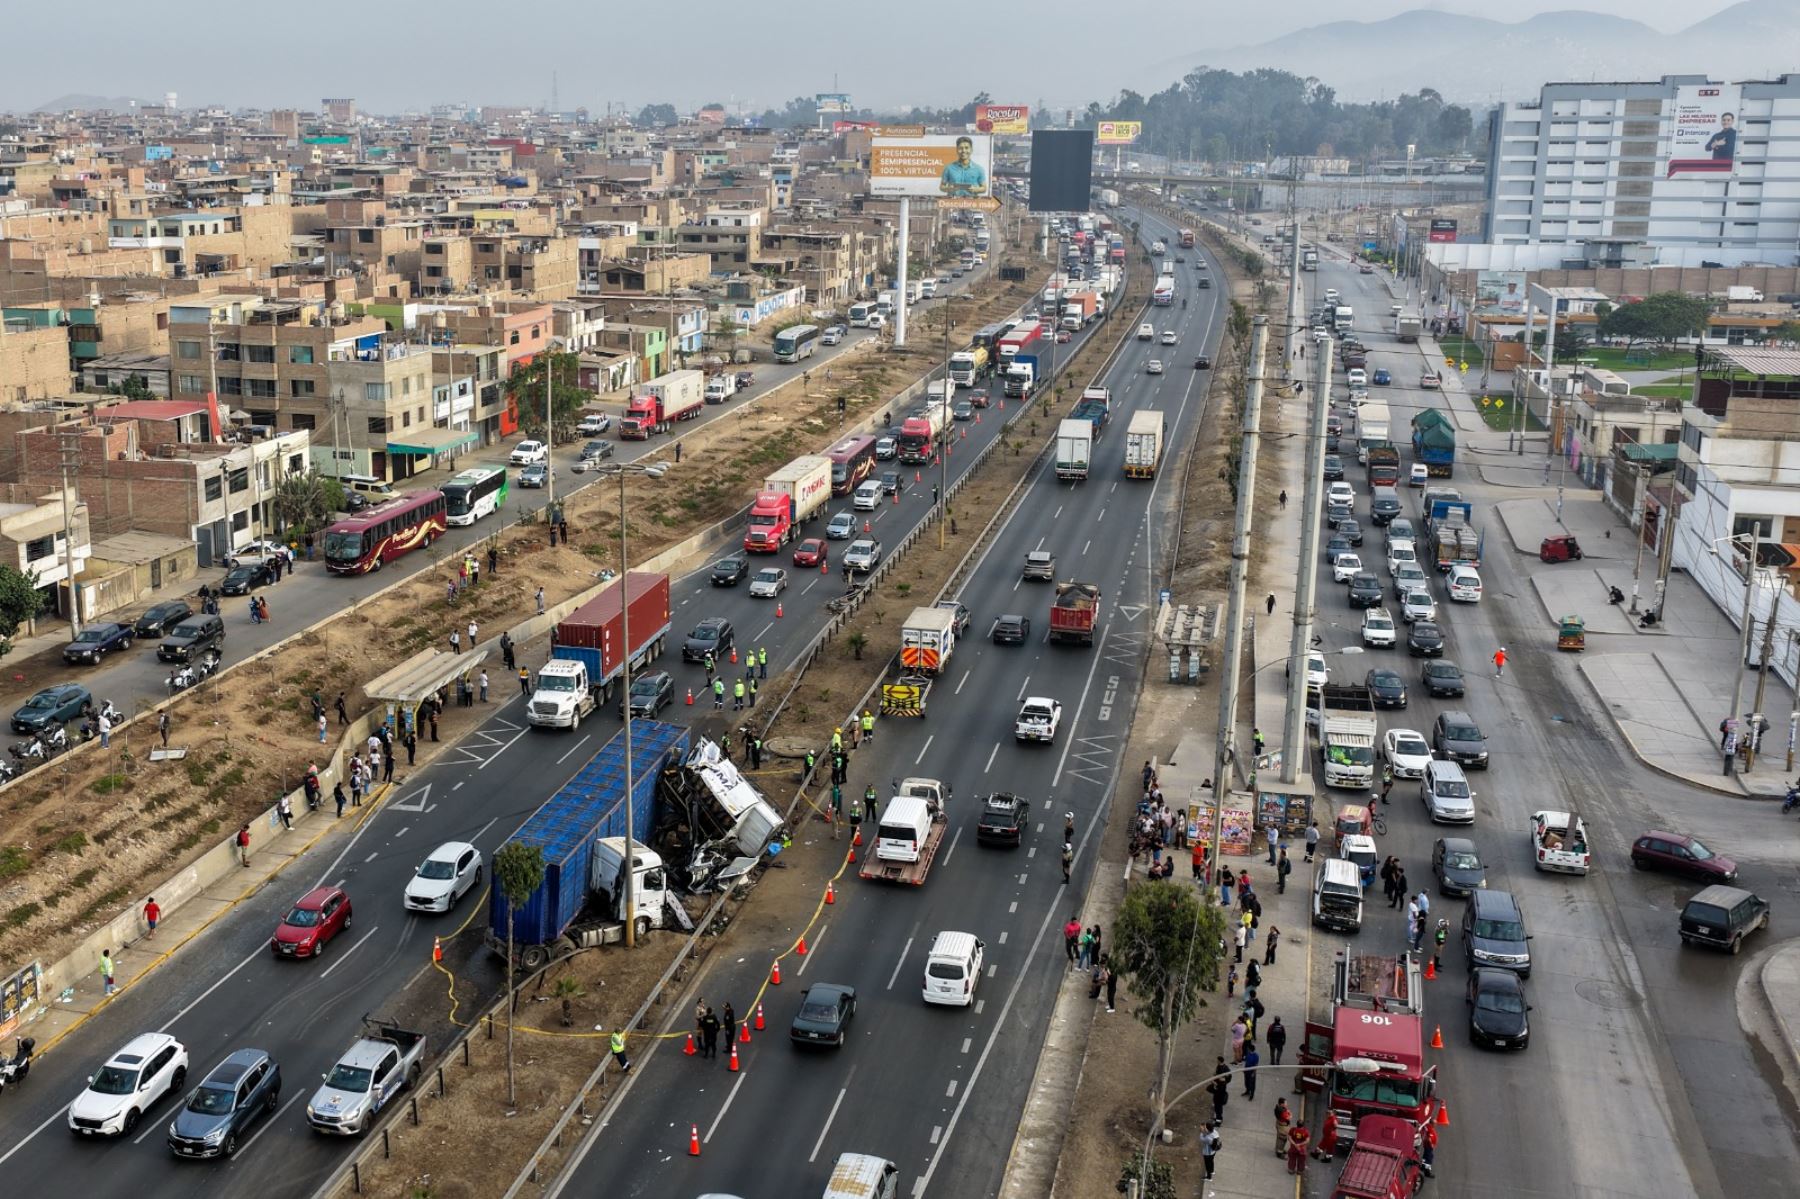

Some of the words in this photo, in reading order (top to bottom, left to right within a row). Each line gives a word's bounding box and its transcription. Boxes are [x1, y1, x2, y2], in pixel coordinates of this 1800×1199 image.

[880, 149, 928, 157] PRESENCIAL
[880, 167, 901, 175] 100%
[1098, 675, 1120, 720] BUS
[1361, 1014, 1393, 1026] 106
